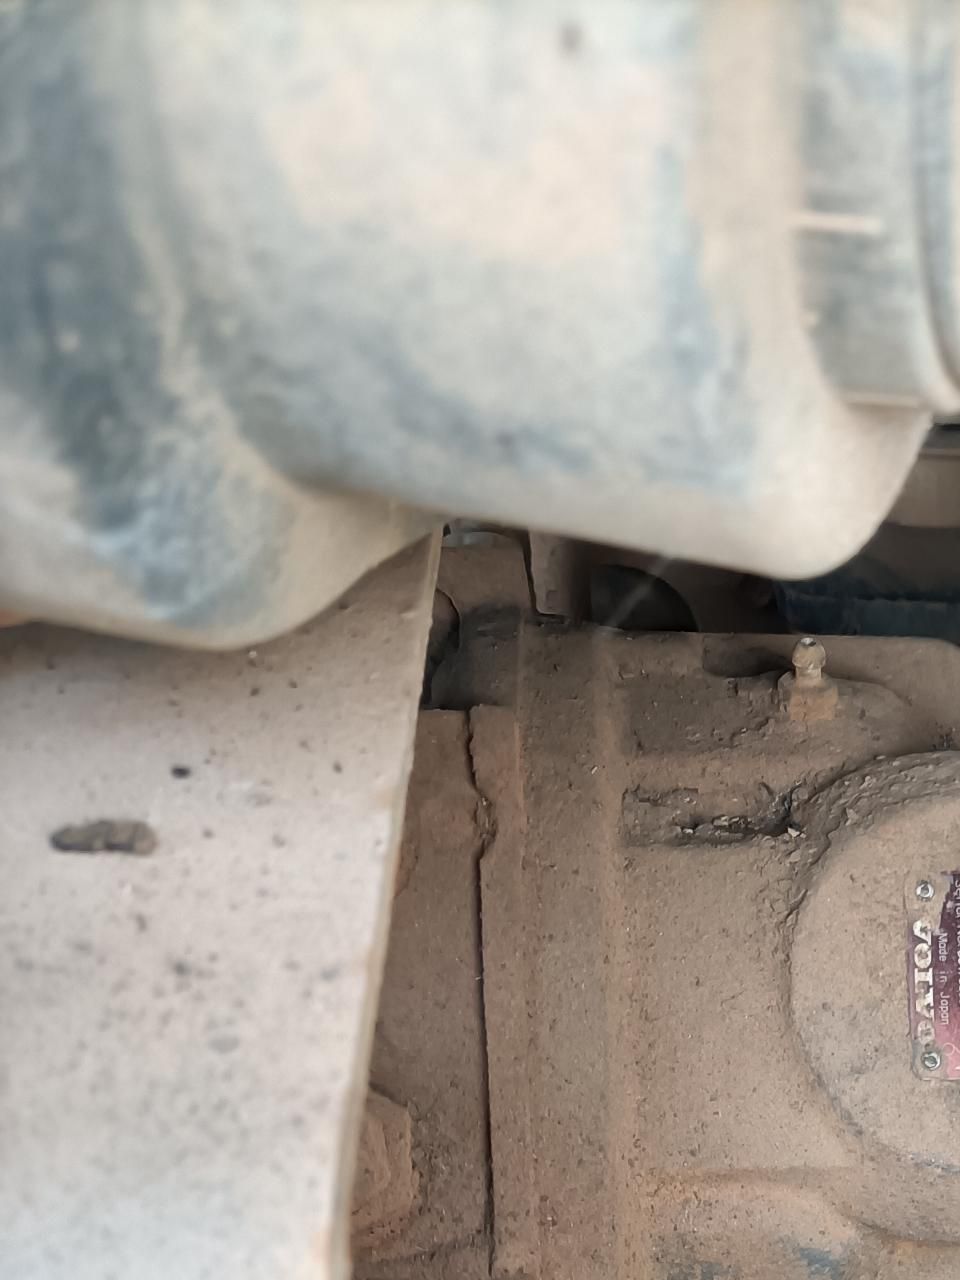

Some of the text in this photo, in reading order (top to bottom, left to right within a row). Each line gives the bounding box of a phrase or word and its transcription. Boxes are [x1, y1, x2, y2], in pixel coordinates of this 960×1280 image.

[913, 920, 935, 1045] VOLVO
[938, 933, 949, 1025] Made in Japan
